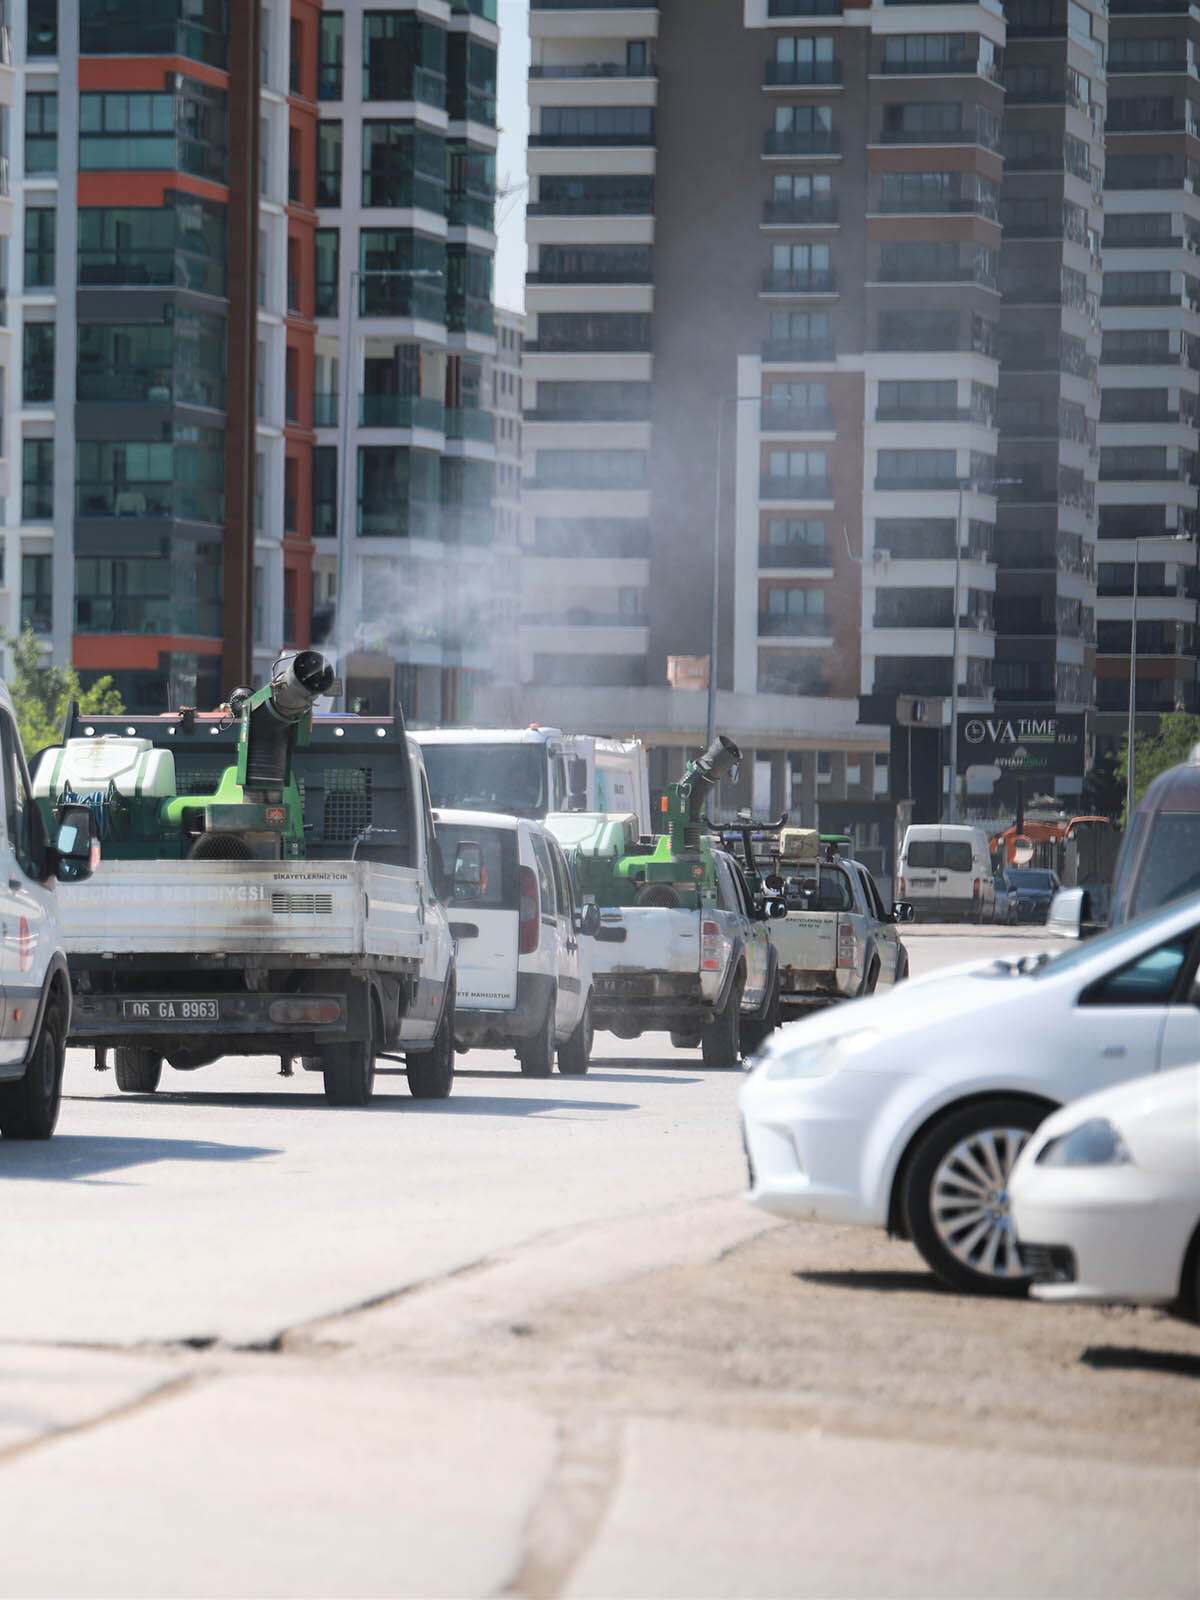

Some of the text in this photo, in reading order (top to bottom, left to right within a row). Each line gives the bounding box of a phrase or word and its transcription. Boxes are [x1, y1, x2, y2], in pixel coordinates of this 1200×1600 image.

[1018, 719, 1056, 735] TIME
[133, 1002, 216, 1017] 06 GA 8963
